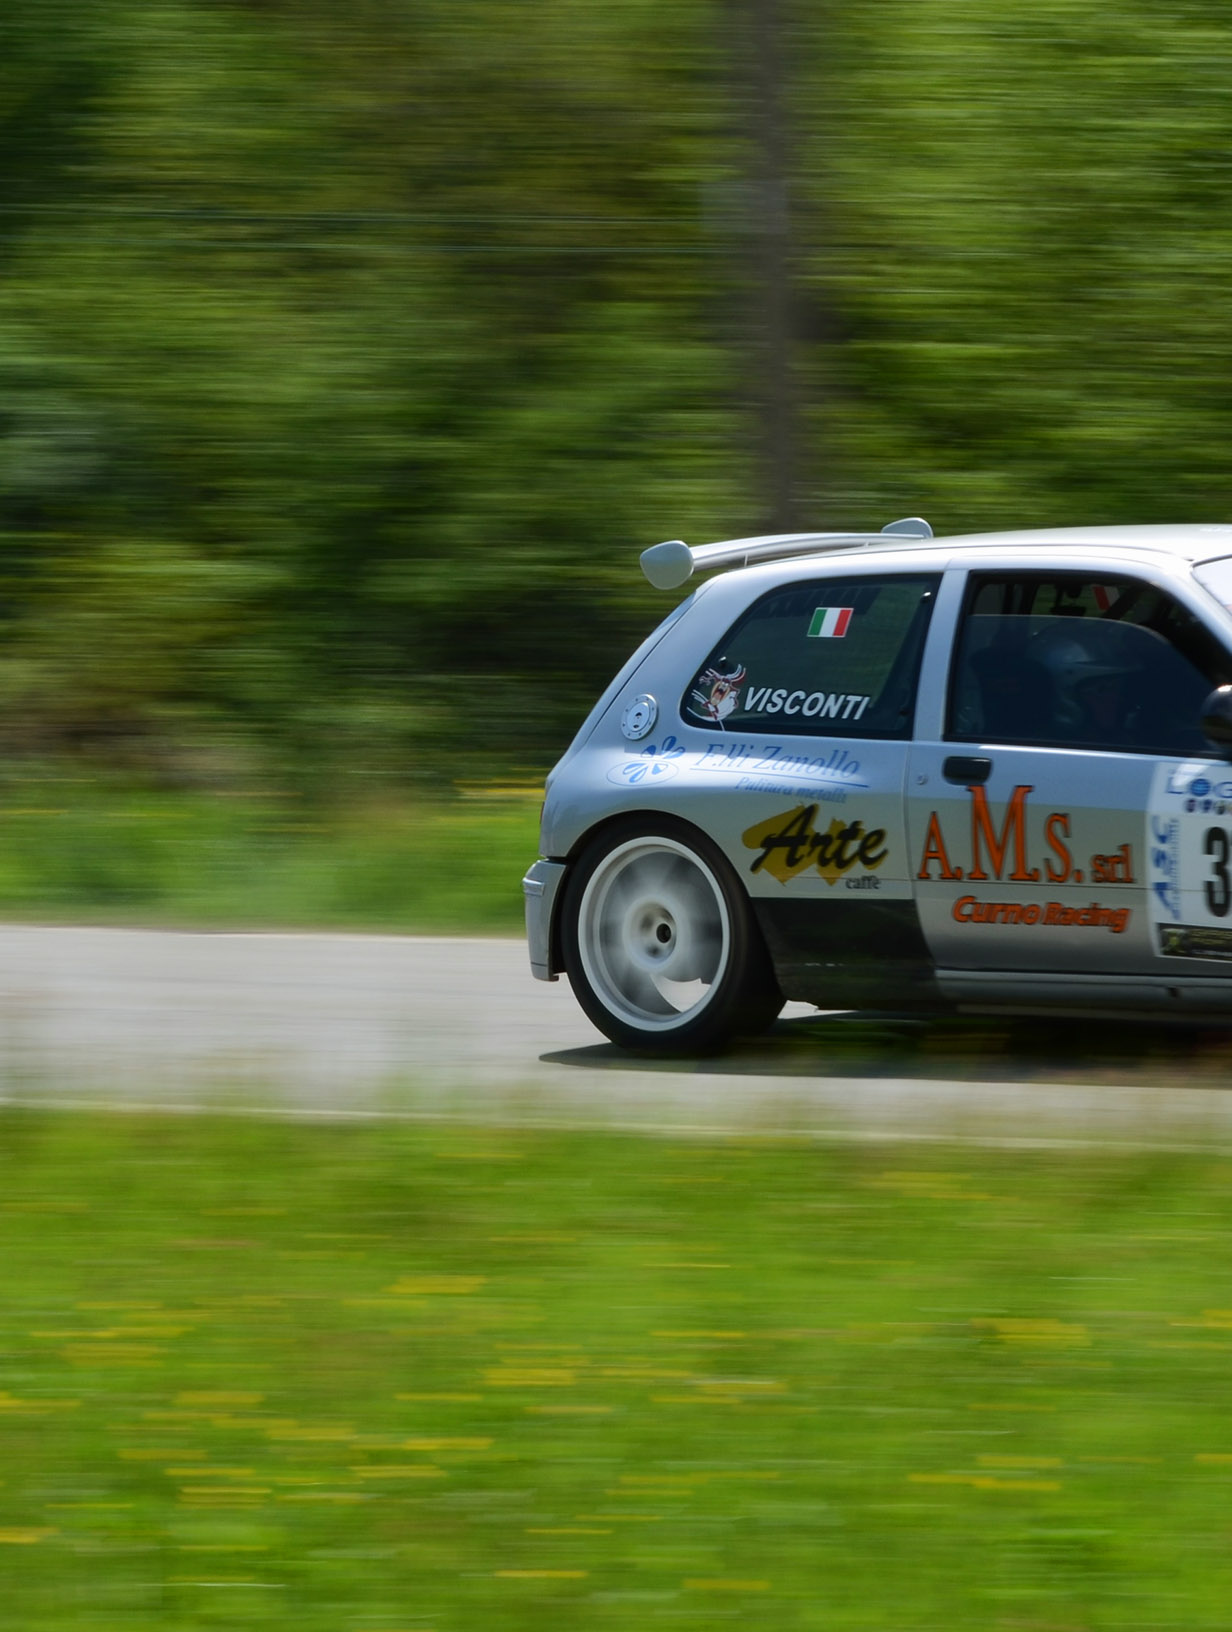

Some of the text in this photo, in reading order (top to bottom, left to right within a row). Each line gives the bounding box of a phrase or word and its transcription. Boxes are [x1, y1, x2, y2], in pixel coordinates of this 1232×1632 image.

[743, 686, 871, 721] VISCONTI
[750, 803, 889, 870] Arte
[1091, 843, 1136, 883] srl
[953, 895, 1132, 934] Curno Racing
